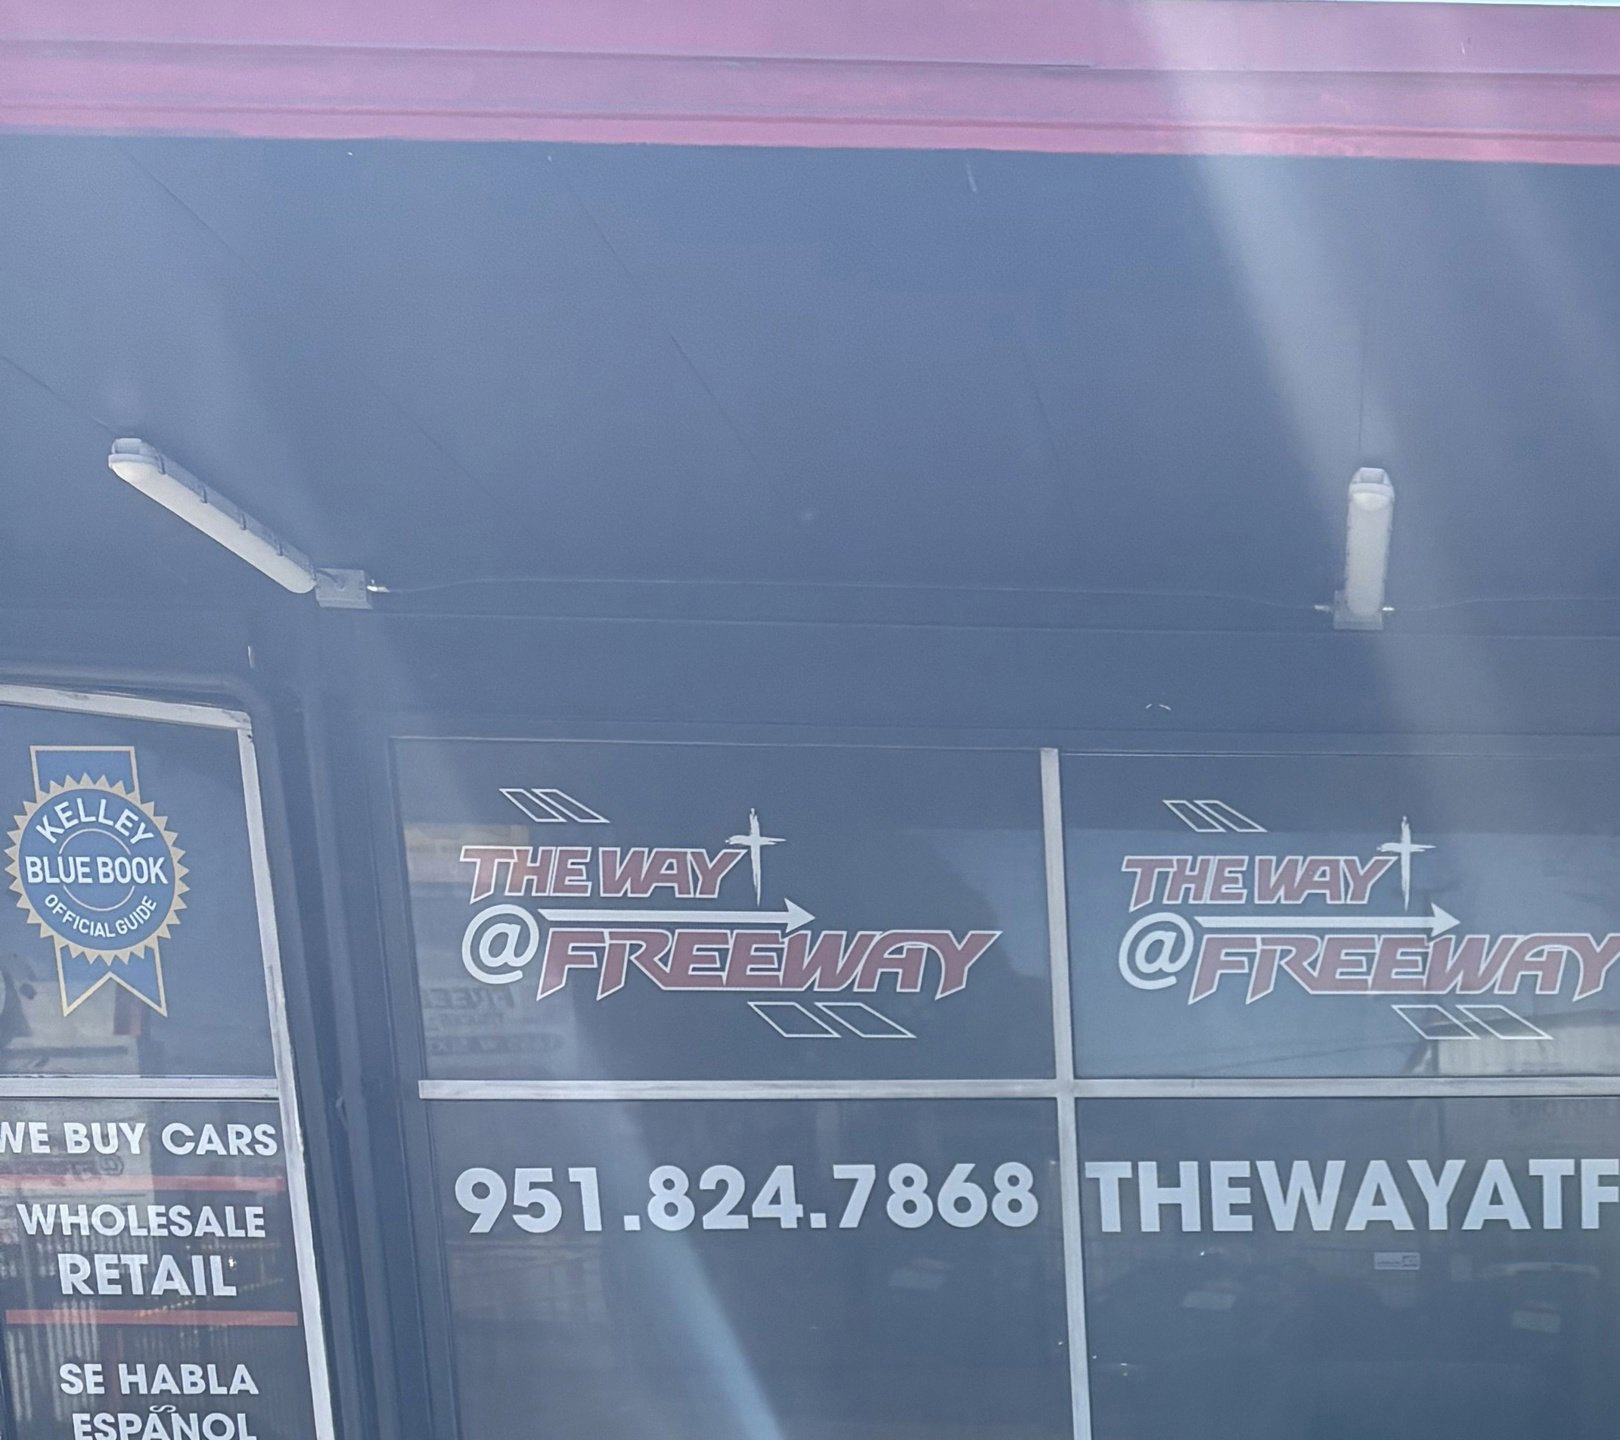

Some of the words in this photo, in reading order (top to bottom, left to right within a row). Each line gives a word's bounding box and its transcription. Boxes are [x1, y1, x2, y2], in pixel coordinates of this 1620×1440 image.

[36, 798, 154, 845] KELLEY
[25, 856, 93, 884] BLUE
[97, 857, 168, 885] BOOK
[44, 894, 116, 938] OFFICIAL
[117, 895, 157, 935] GUIDE
[461, 904, 1003, 1000] @FREEWAY
[63, 1122, 146, 1154] BUY
[162, 1122, 278, 1156] CARS
[455, 1161, 1039, 1233] 951.824.7868
[16, 1203, 266, 1238] WHOLESALE
[57, 1254, 237, 1297] RETAIL
[59, 1364, 105, 1394] SE
[118, 1363, 259, 1395] HABLA
